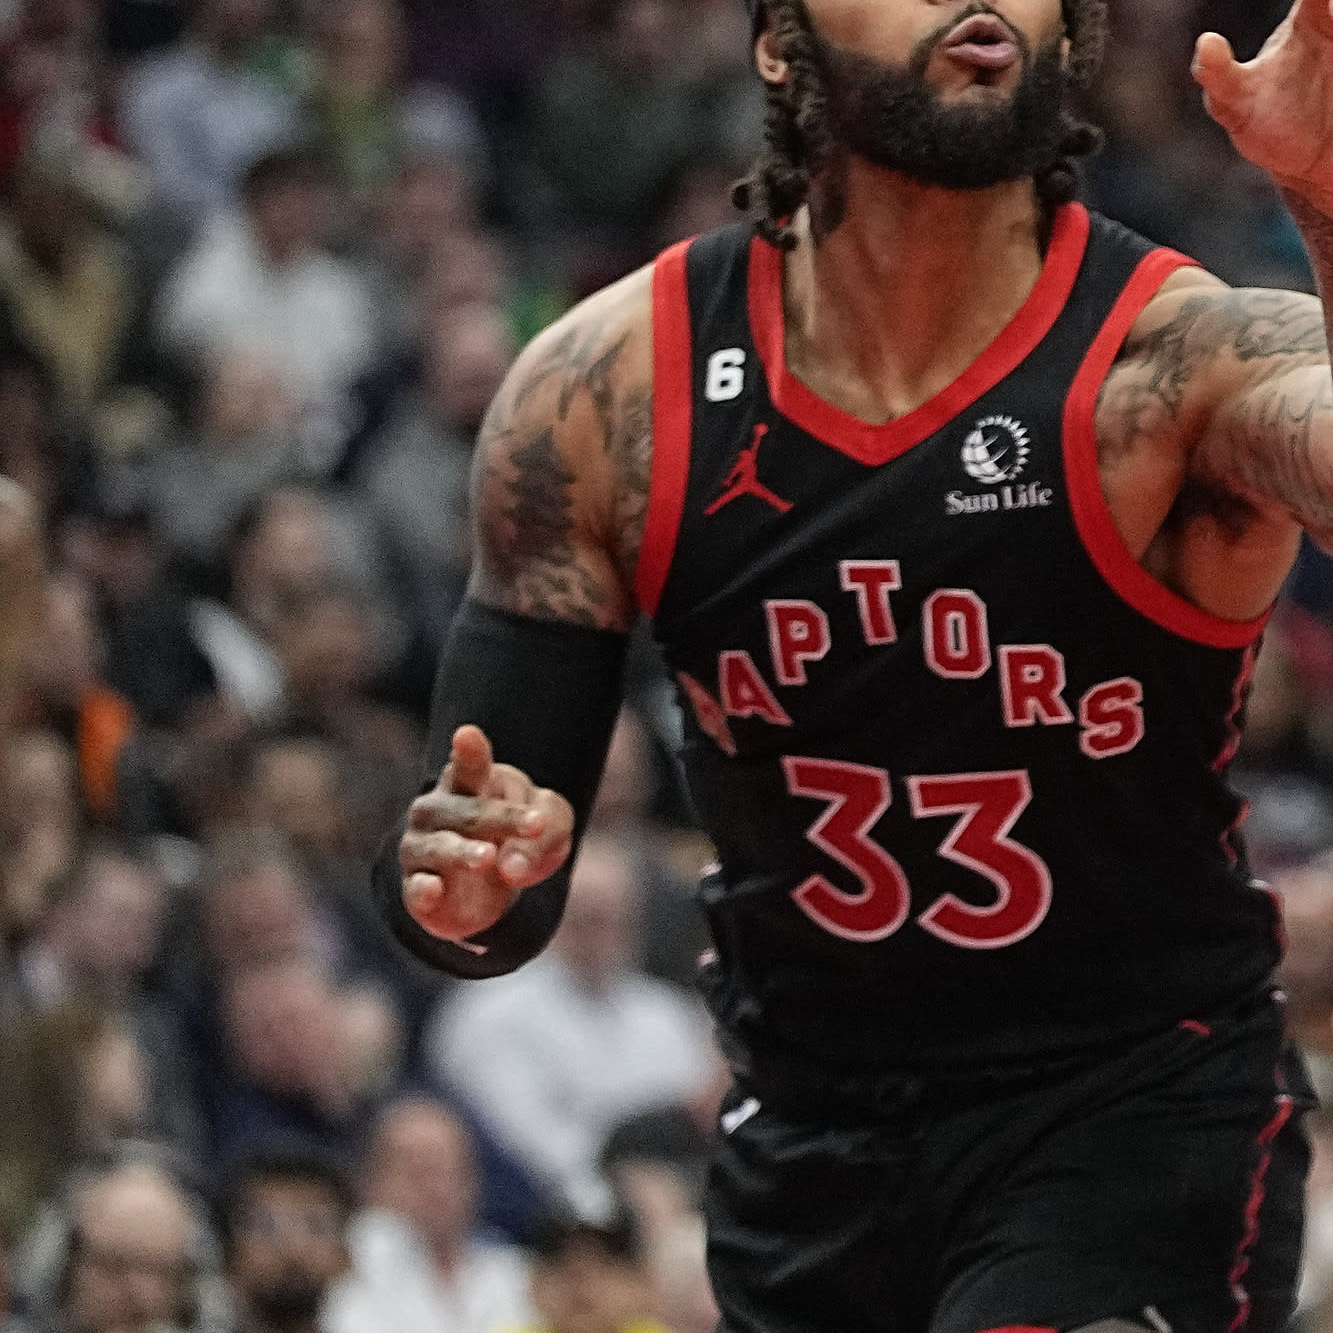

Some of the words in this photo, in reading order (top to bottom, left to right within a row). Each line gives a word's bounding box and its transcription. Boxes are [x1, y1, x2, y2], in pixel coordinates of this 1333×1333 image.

[705, 347, 746, 402] 6
[944, 489, 999, 516] Sun
[1002, 480, 1054, 509] Life
[779, 755, 1054, 950] 33
